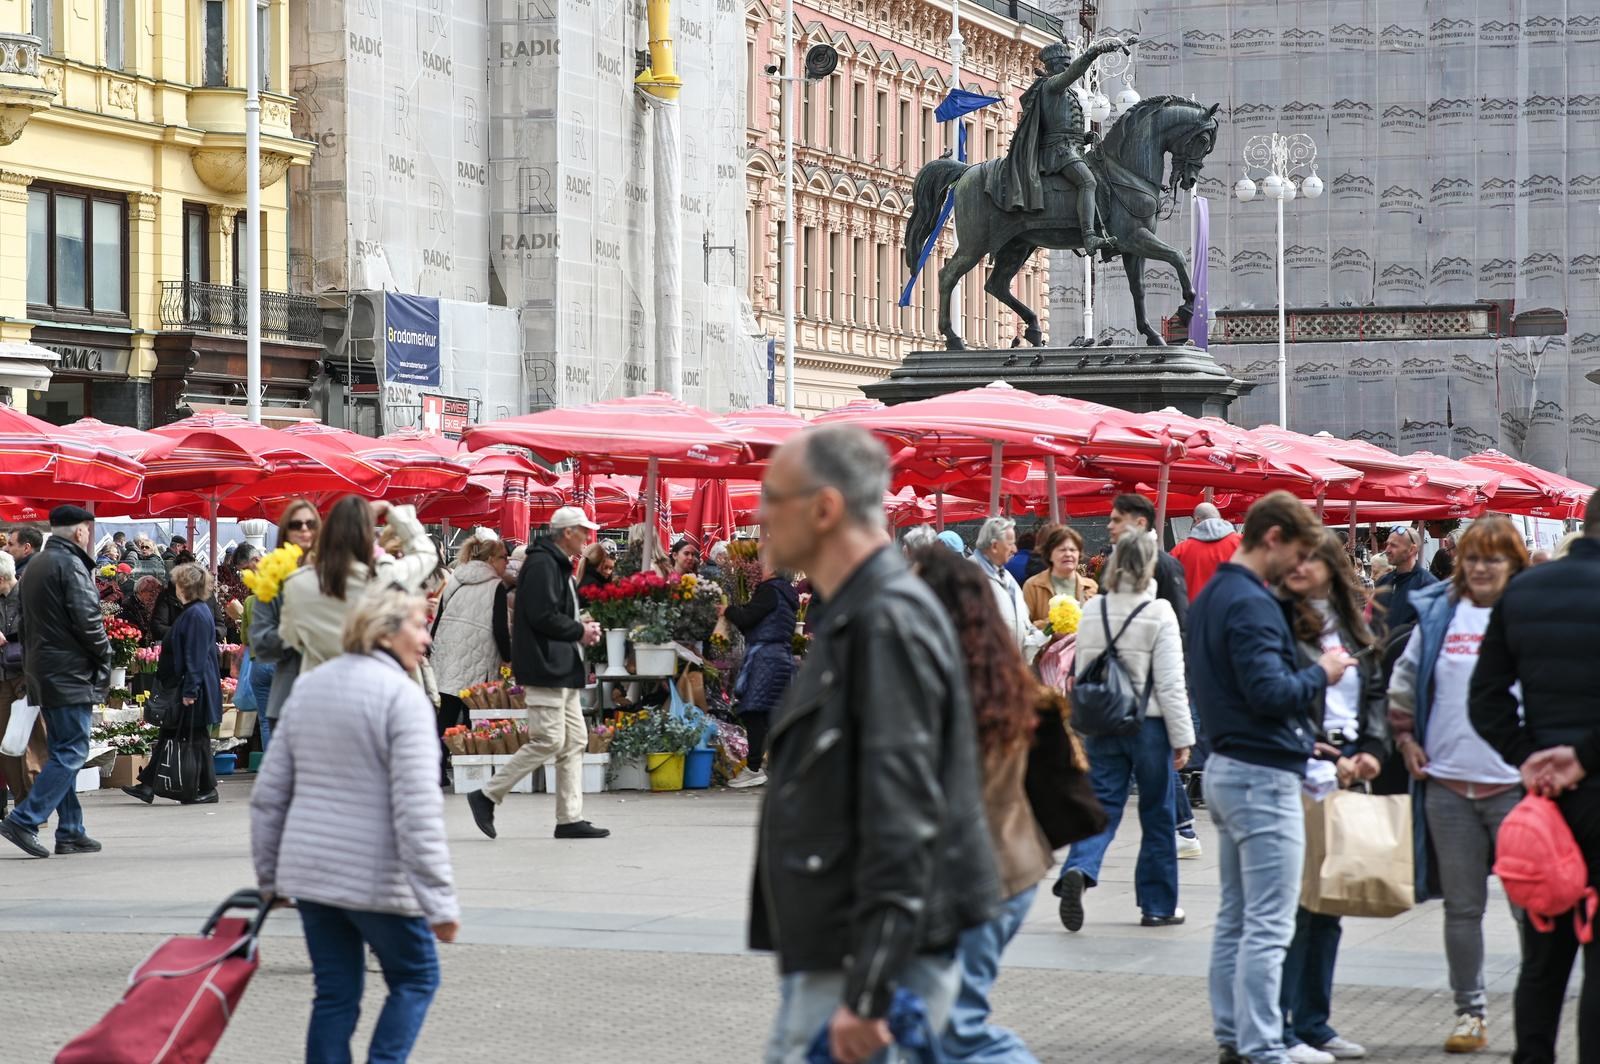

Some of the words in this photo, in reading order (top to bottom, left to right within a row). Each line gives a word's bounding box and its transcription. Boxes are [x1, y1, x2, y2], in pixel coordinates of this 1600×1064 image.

[350, 32, 382, 58] RADIĆ
[423, 50, 452, 76] RADIĆ
[598, 52, 621, 76] RADIĆ
[389, 154, 415, 180] RADIĆ
[458, 160, 485, 186] RADIĆ
[567, 175, 591, 196] RADIĆ
[424, 248, 450, 271] RADIĆ
[596, 239, 620, 260] RADIĆ
[388, 326, 436, 348] Brodomerkur
[566, 365, 590, 386] RADIĆ
[624, 362, 647, 382] RADIĆ
[444, 401, 468, 414] SWISS
[729, 391, 750, 409] RADIĆ
